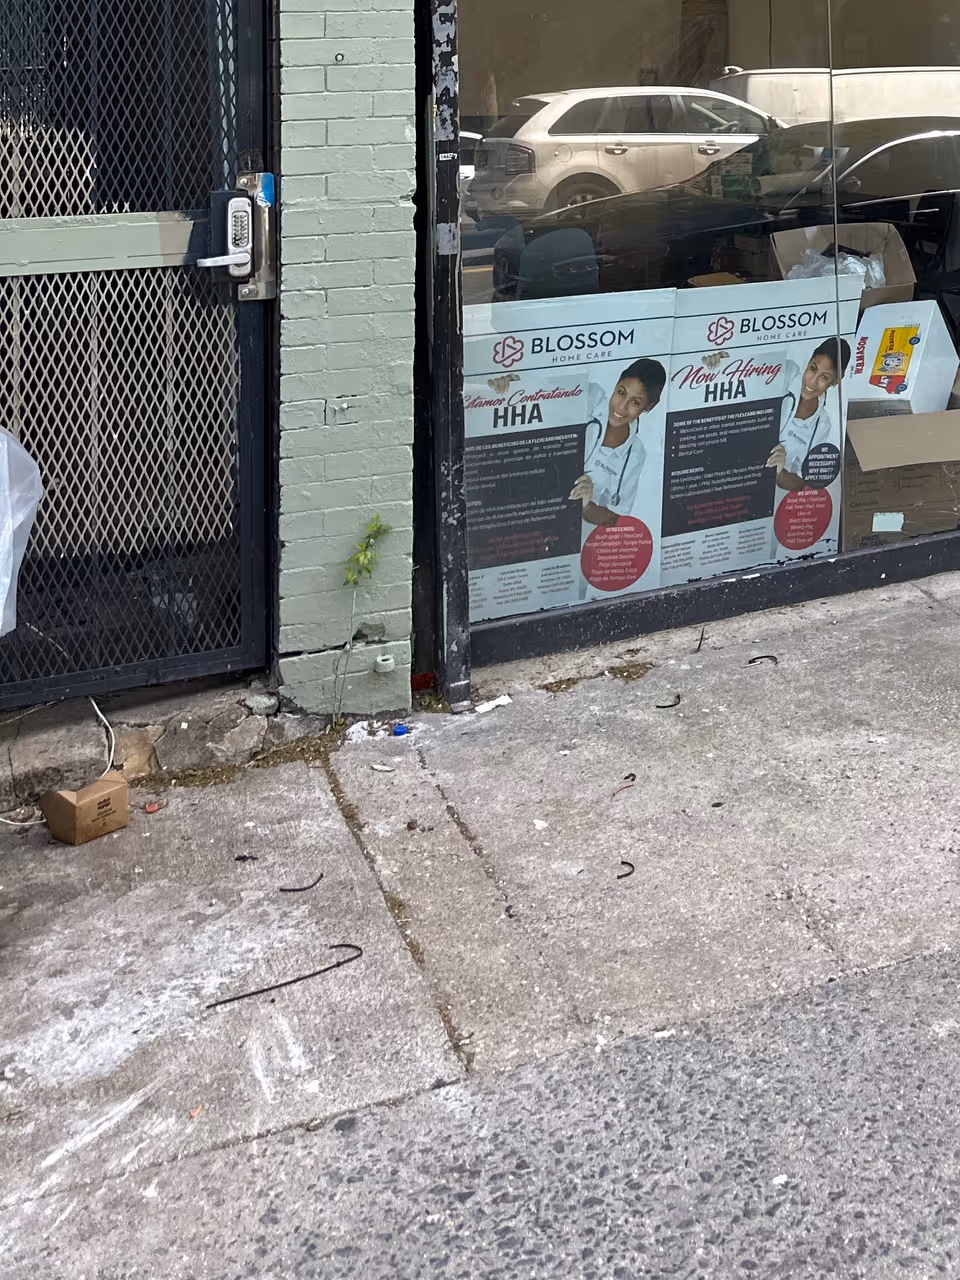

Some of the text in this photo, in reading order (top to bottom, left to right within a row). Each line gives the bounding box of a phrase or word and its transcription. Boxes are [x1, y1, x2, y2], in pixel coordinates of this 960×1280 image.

[740, 310, 828, 334] BLOSSOM
[531, 328, 634, 355] BLOSSOM
[757, 330, 807, 342] HOME CARE
[552, 351, 612, 363] HOME CARE
[671, 358, 782, 390] Now Hiring
[507, 384, 584, 407] Contratando
[704, 379, 746, 403] HHA
[493, 403, 543, 429] HHA
